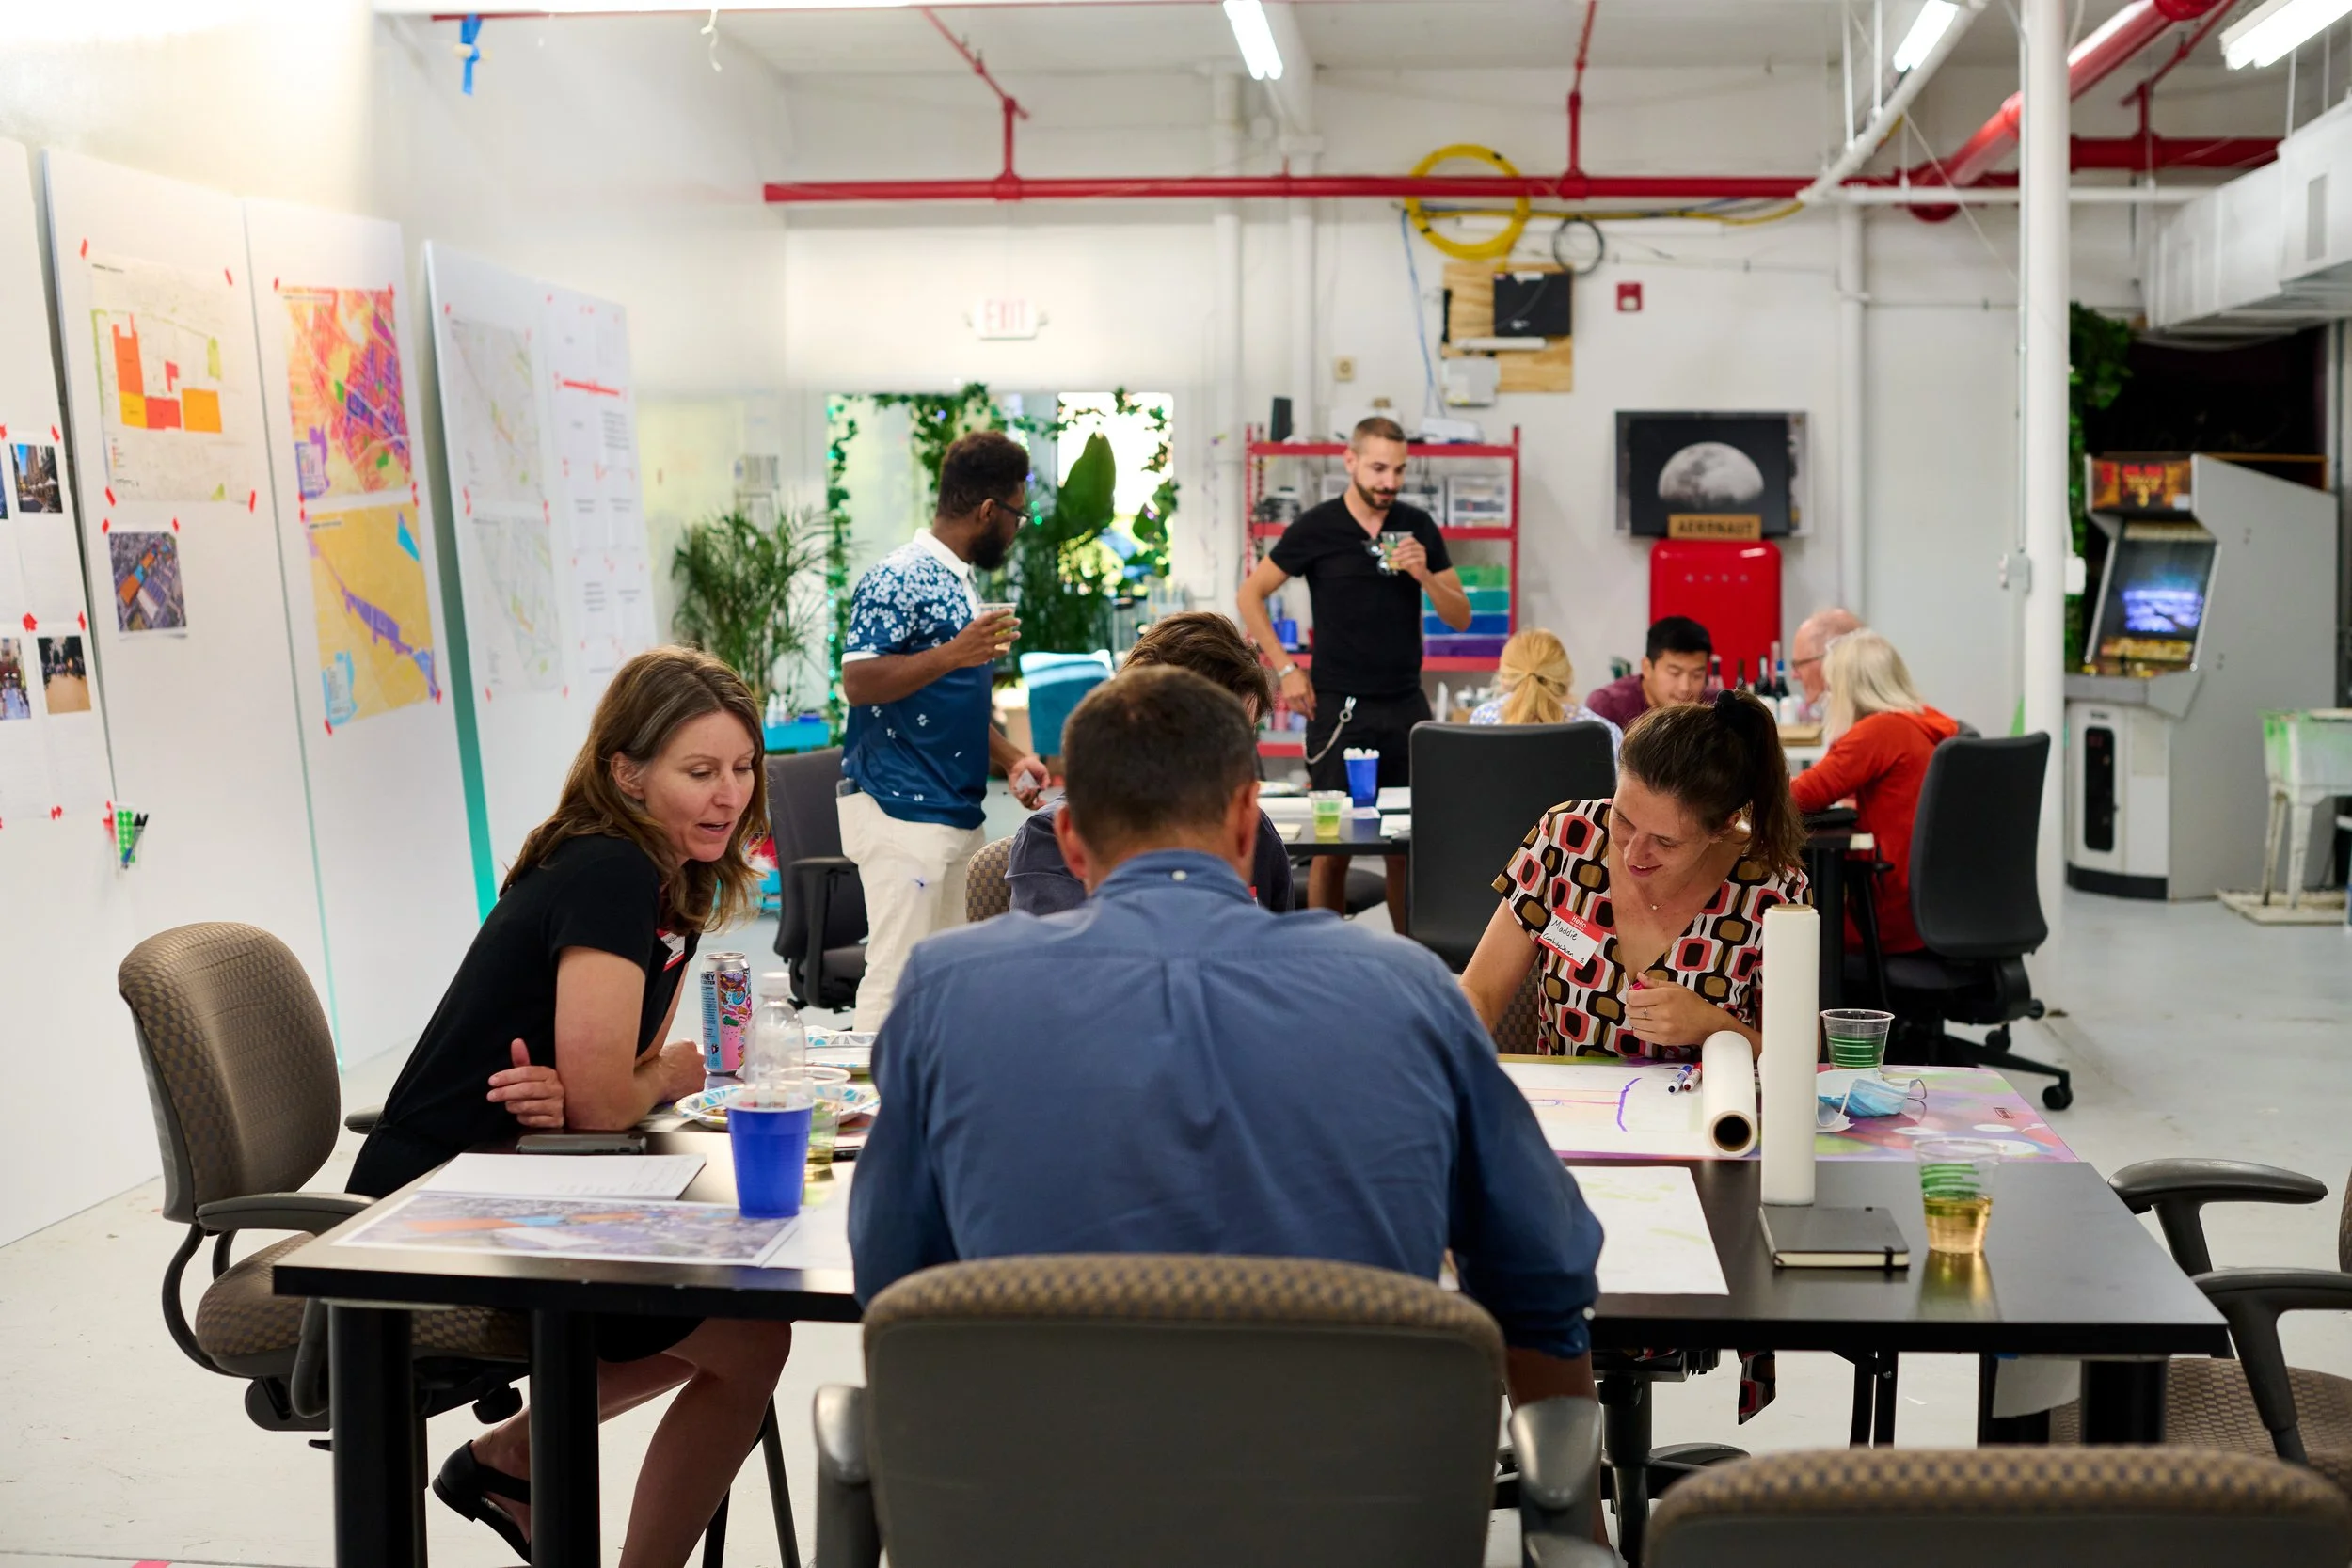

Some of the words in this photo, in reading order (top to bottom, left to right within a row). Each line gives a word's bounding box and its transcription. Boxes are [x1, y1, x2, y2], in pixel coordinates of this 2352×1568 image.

[984, 298, 1027, 332] EXIT
[1677, 519, 1754, 535] AERONAUT
[1551, 919, 1578, 941] Maddie
[1571, 915, 1587, 928] Hello
